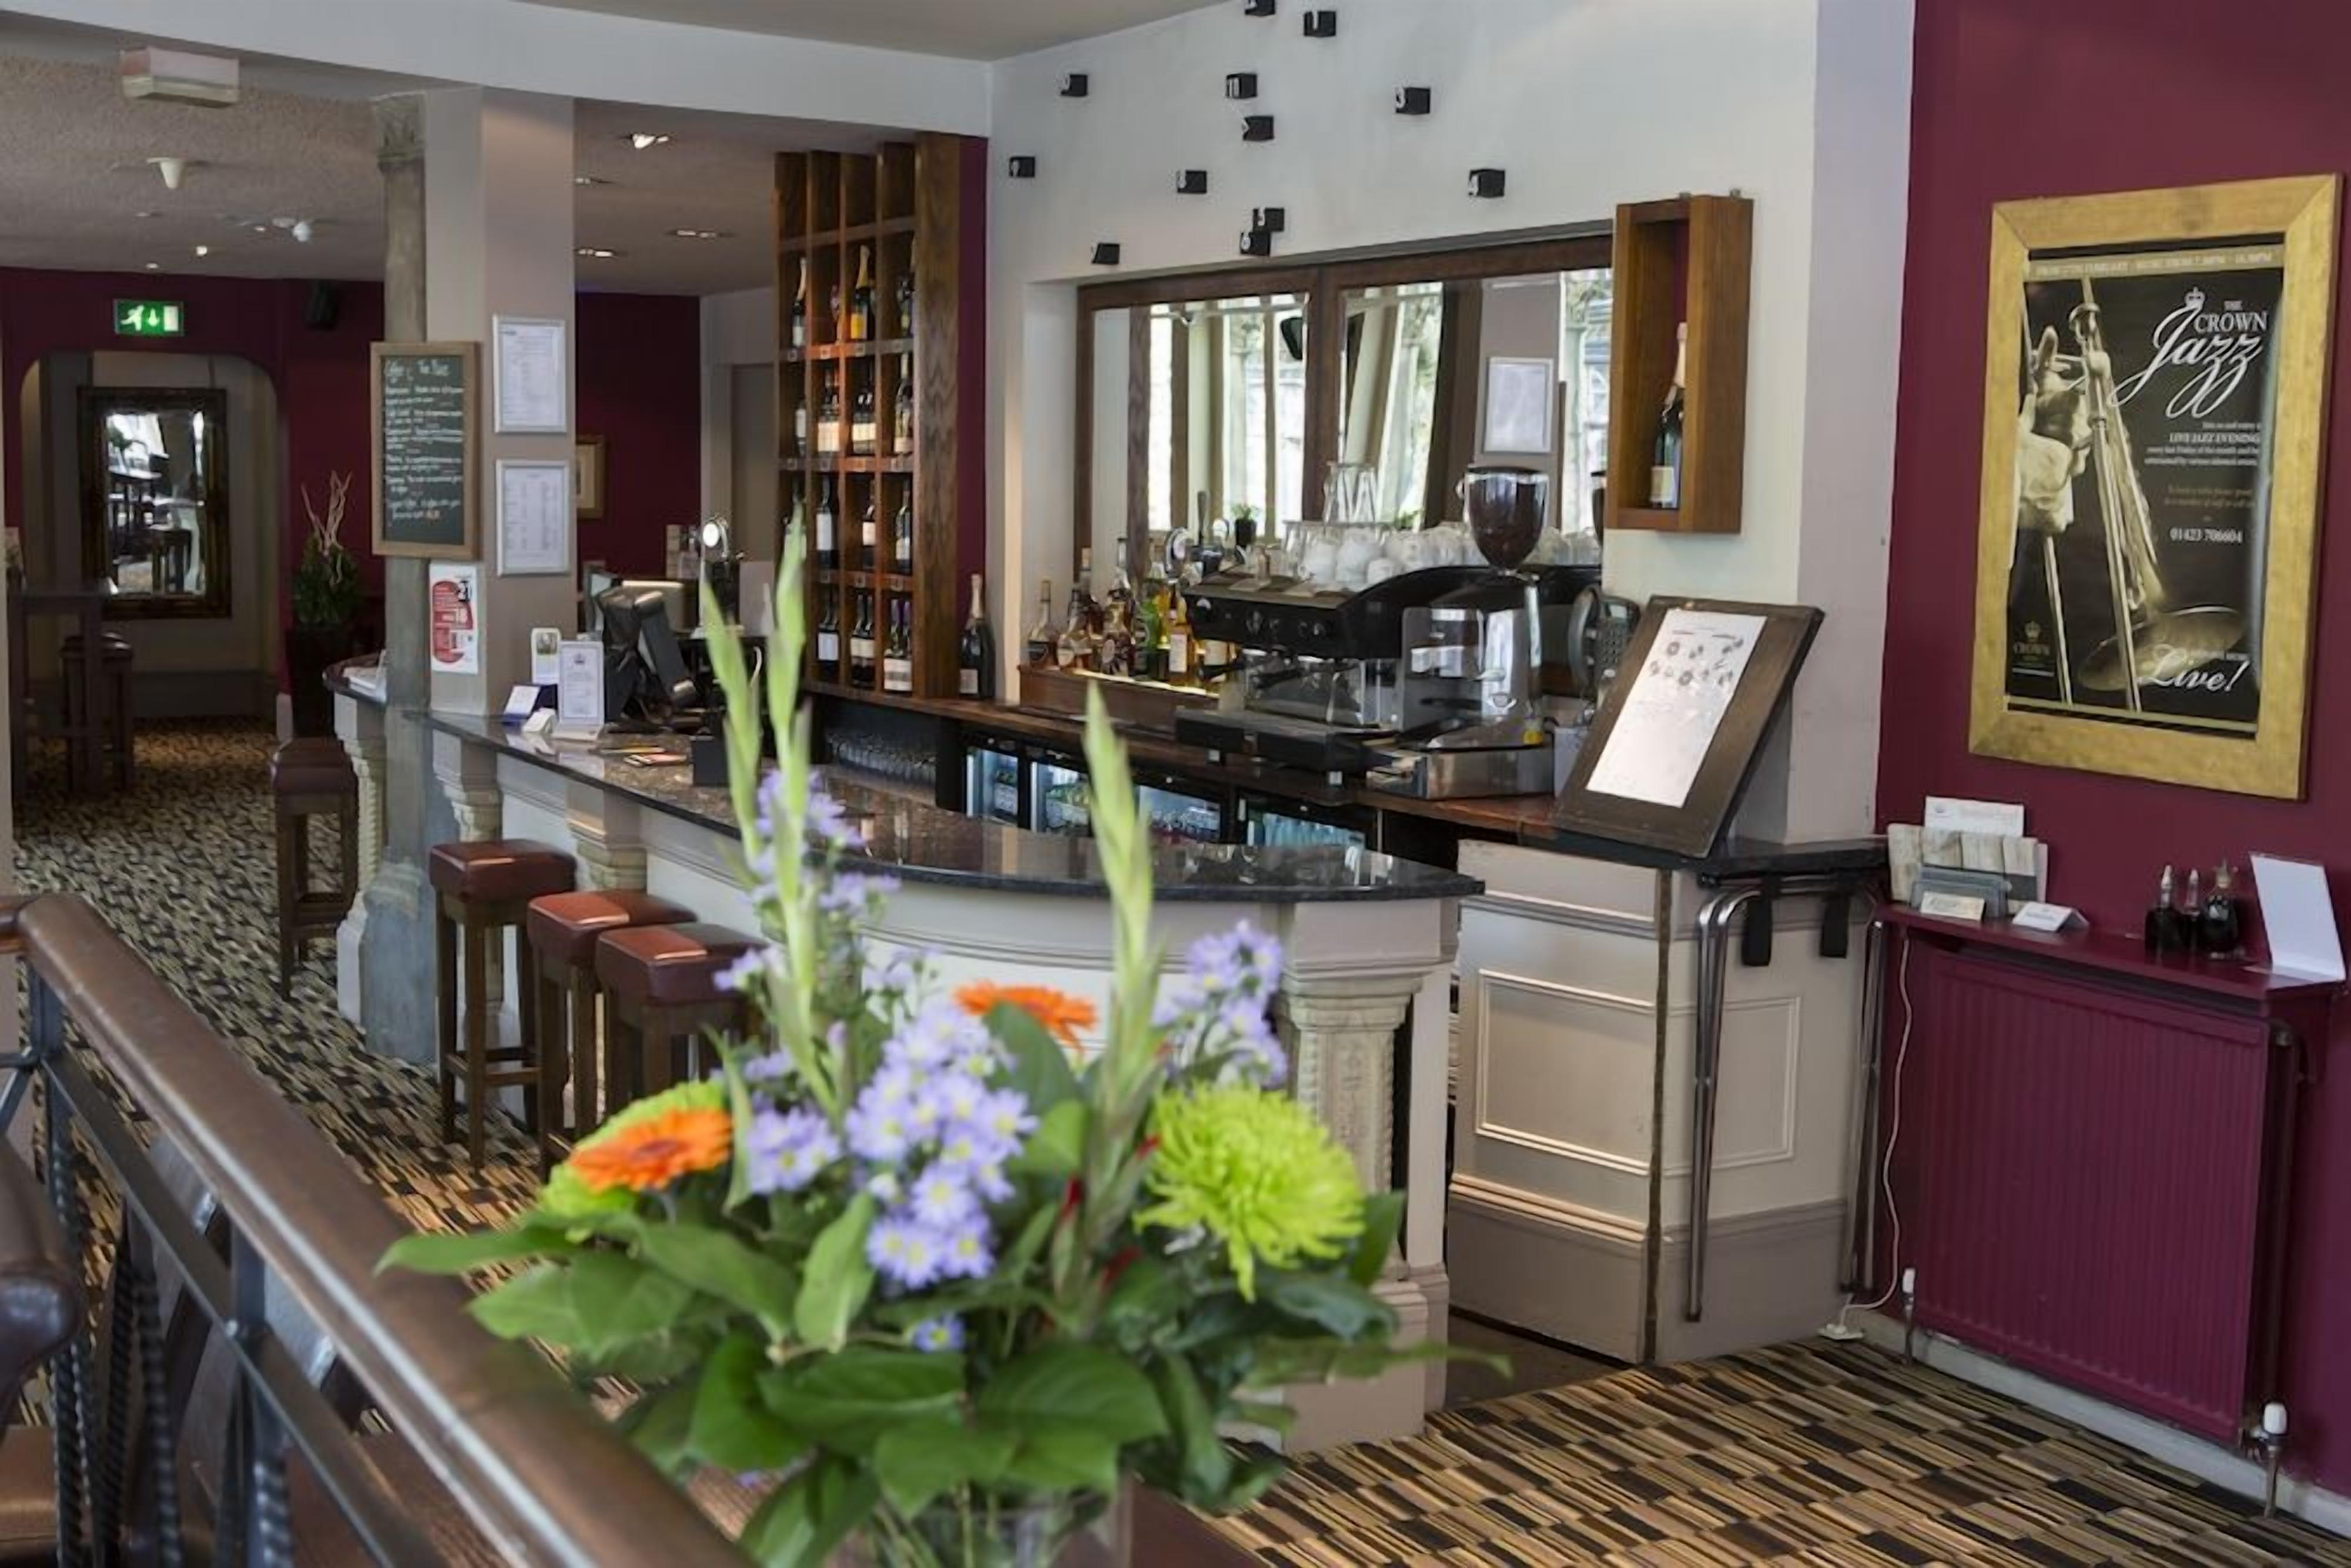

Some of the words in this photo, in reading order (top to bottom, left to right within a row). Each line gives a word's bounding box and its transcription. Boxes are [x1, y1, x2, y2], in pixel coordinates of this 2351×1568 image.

[2193, 311, 2268, 333] CROWN
[2106, 304, 2263, 418] Jazz
[2138, 644, 2250, 692] Live!
